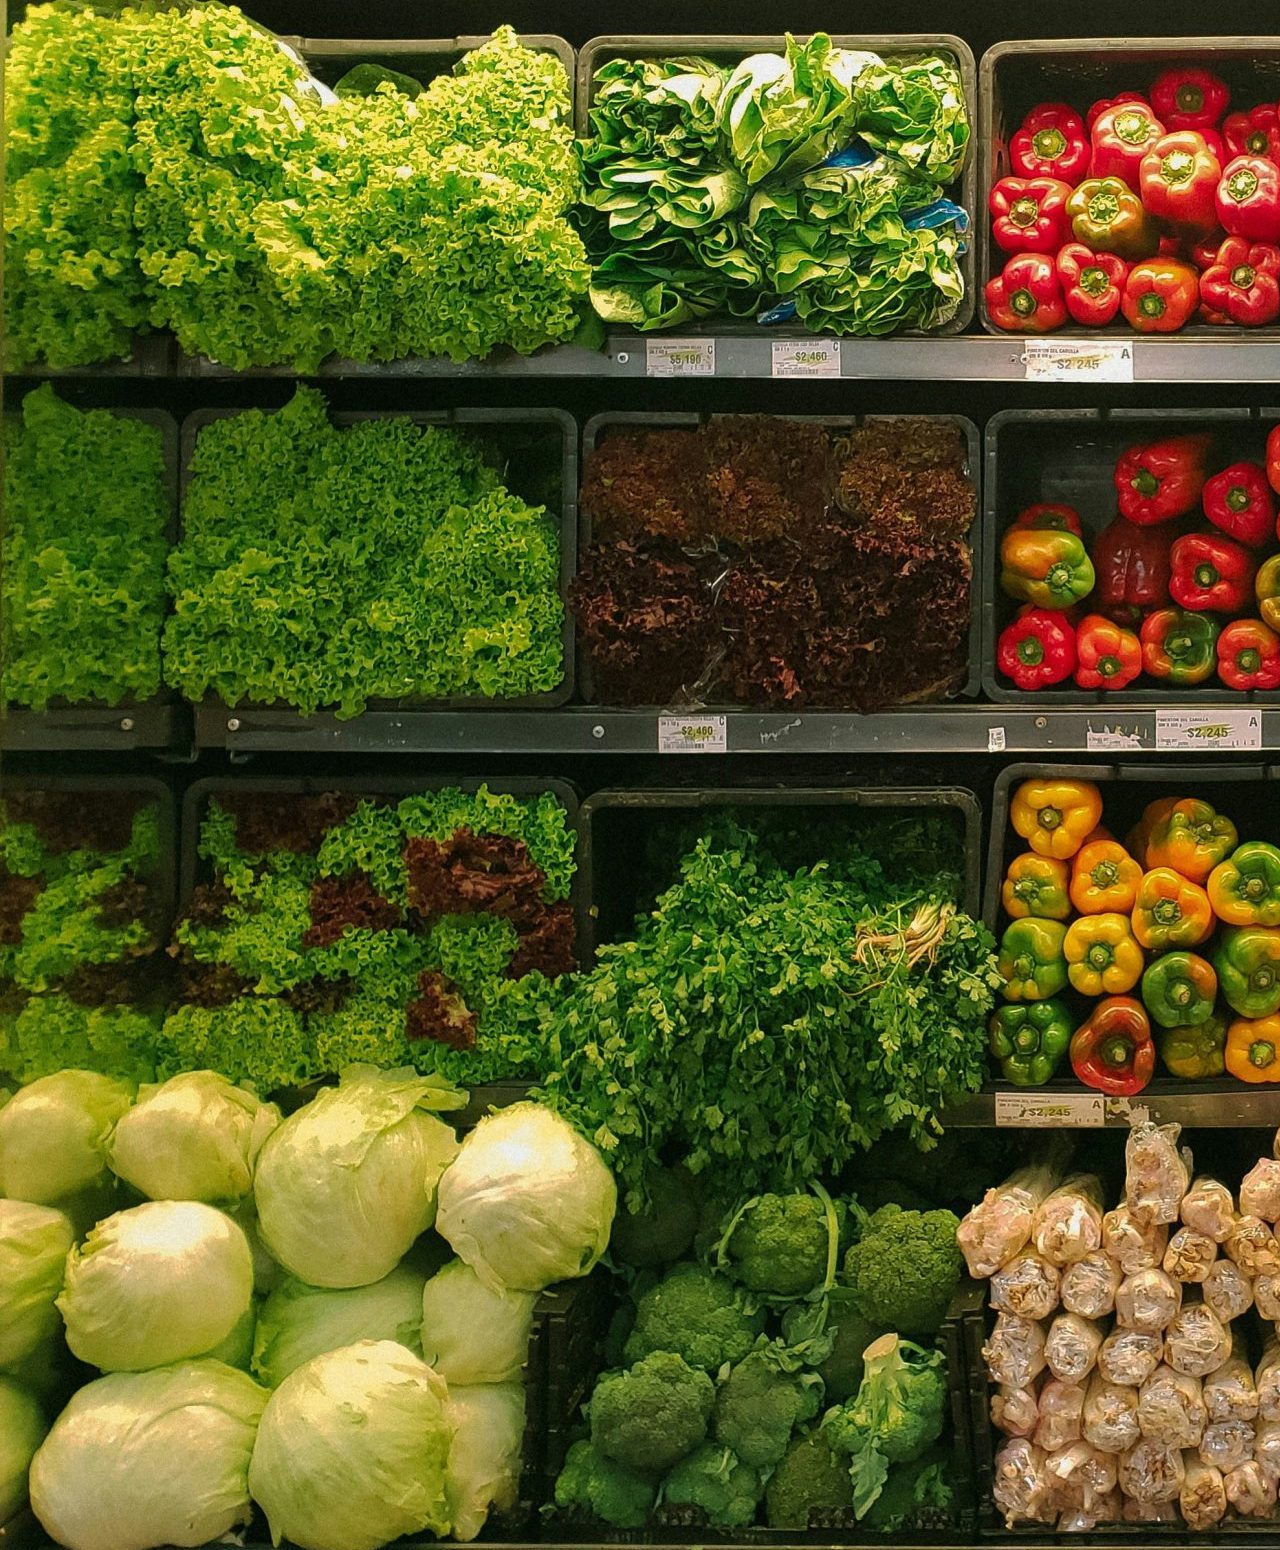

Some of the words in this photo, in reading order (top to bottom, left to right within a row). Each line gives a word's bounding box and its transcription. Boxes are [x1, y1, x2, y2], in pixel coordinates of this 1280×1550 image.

[707, 345, 713, 354] C
[832, 342, 839, 351] C
[795, 351, 827, 362] $2,460
[1121, 348, 1130, 359] A
[670, 354, 701, 366] $5,190
[1057, 359, 1100, 370] $2245
[719, 716, 725, 726] C
[1249, 716, 1258, 727] A
[681, 726, 713, 737] $2,460
[1187, 727, 1229, 739] $2,245
[1092, 1100, 1101, 1109] A
[1028, 1107, 1072, 1118] $2,245
